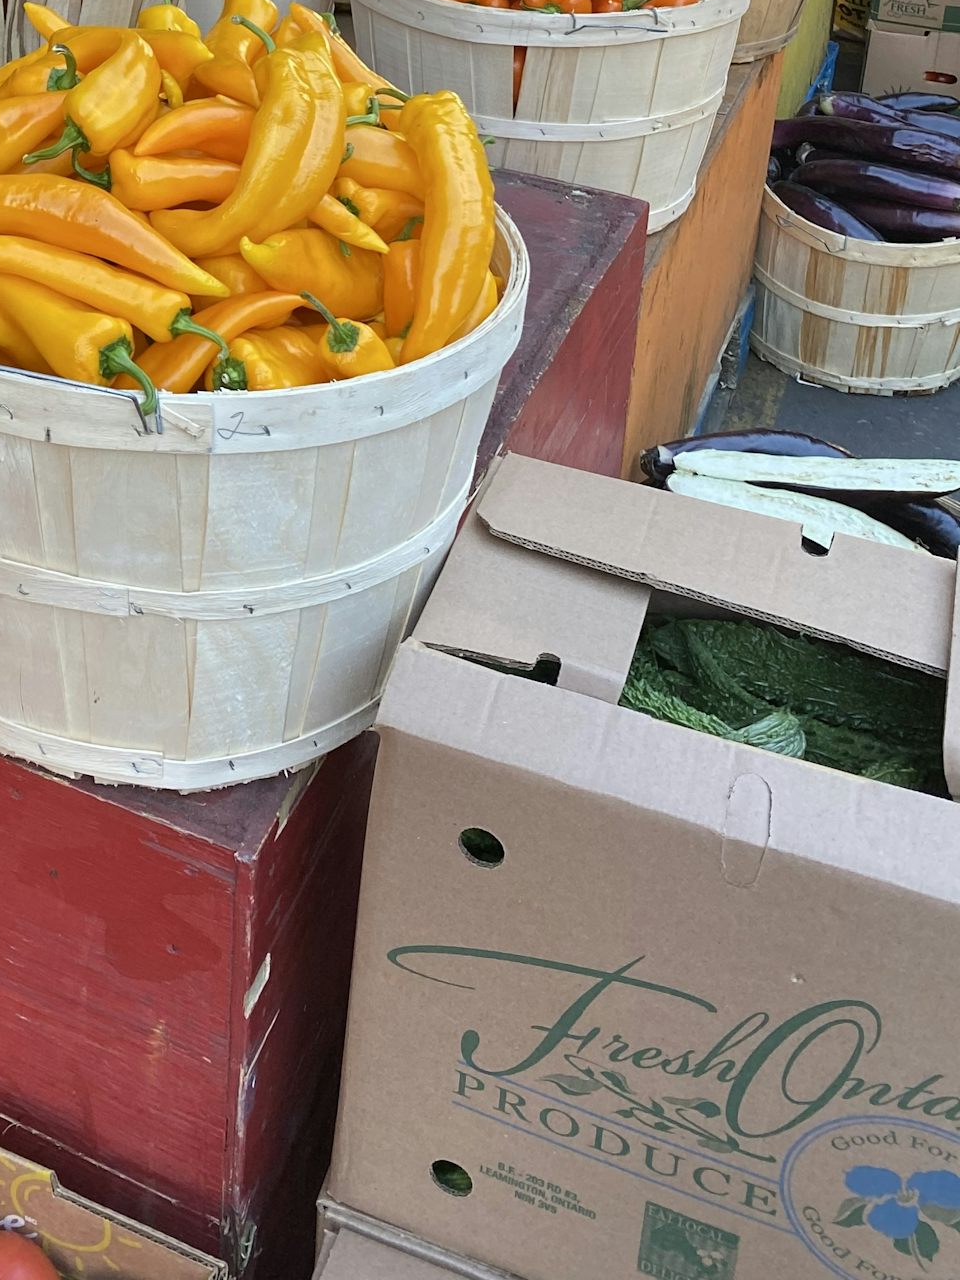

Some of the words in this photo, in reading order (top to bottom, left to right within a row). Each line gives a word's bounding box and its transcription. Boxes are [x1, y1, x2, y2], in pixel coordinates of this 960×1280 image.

[891, 1, 927, 16] FRESH
[387, 945, 769, 1083] Fresh
[726, 1000, 960, 1137] Onta
[454, 1069, 780, 1217] PRODUCE
[831, 1131, 899, 1152] Good
[910, 1135, 959, 1165] For
[480, 1164, 548, 1201] LEAMINGTON,
[551, 1194, 597, 1220] ONTARIO
[498, 1161, 516, 1174] B.F.
[526, 1173, 545, 1188] 203
[546, 1182, 562, 1194] RD
[678, 1216, 724, 1243] LOCAL
[802, 1205, 851, 1261] Good
